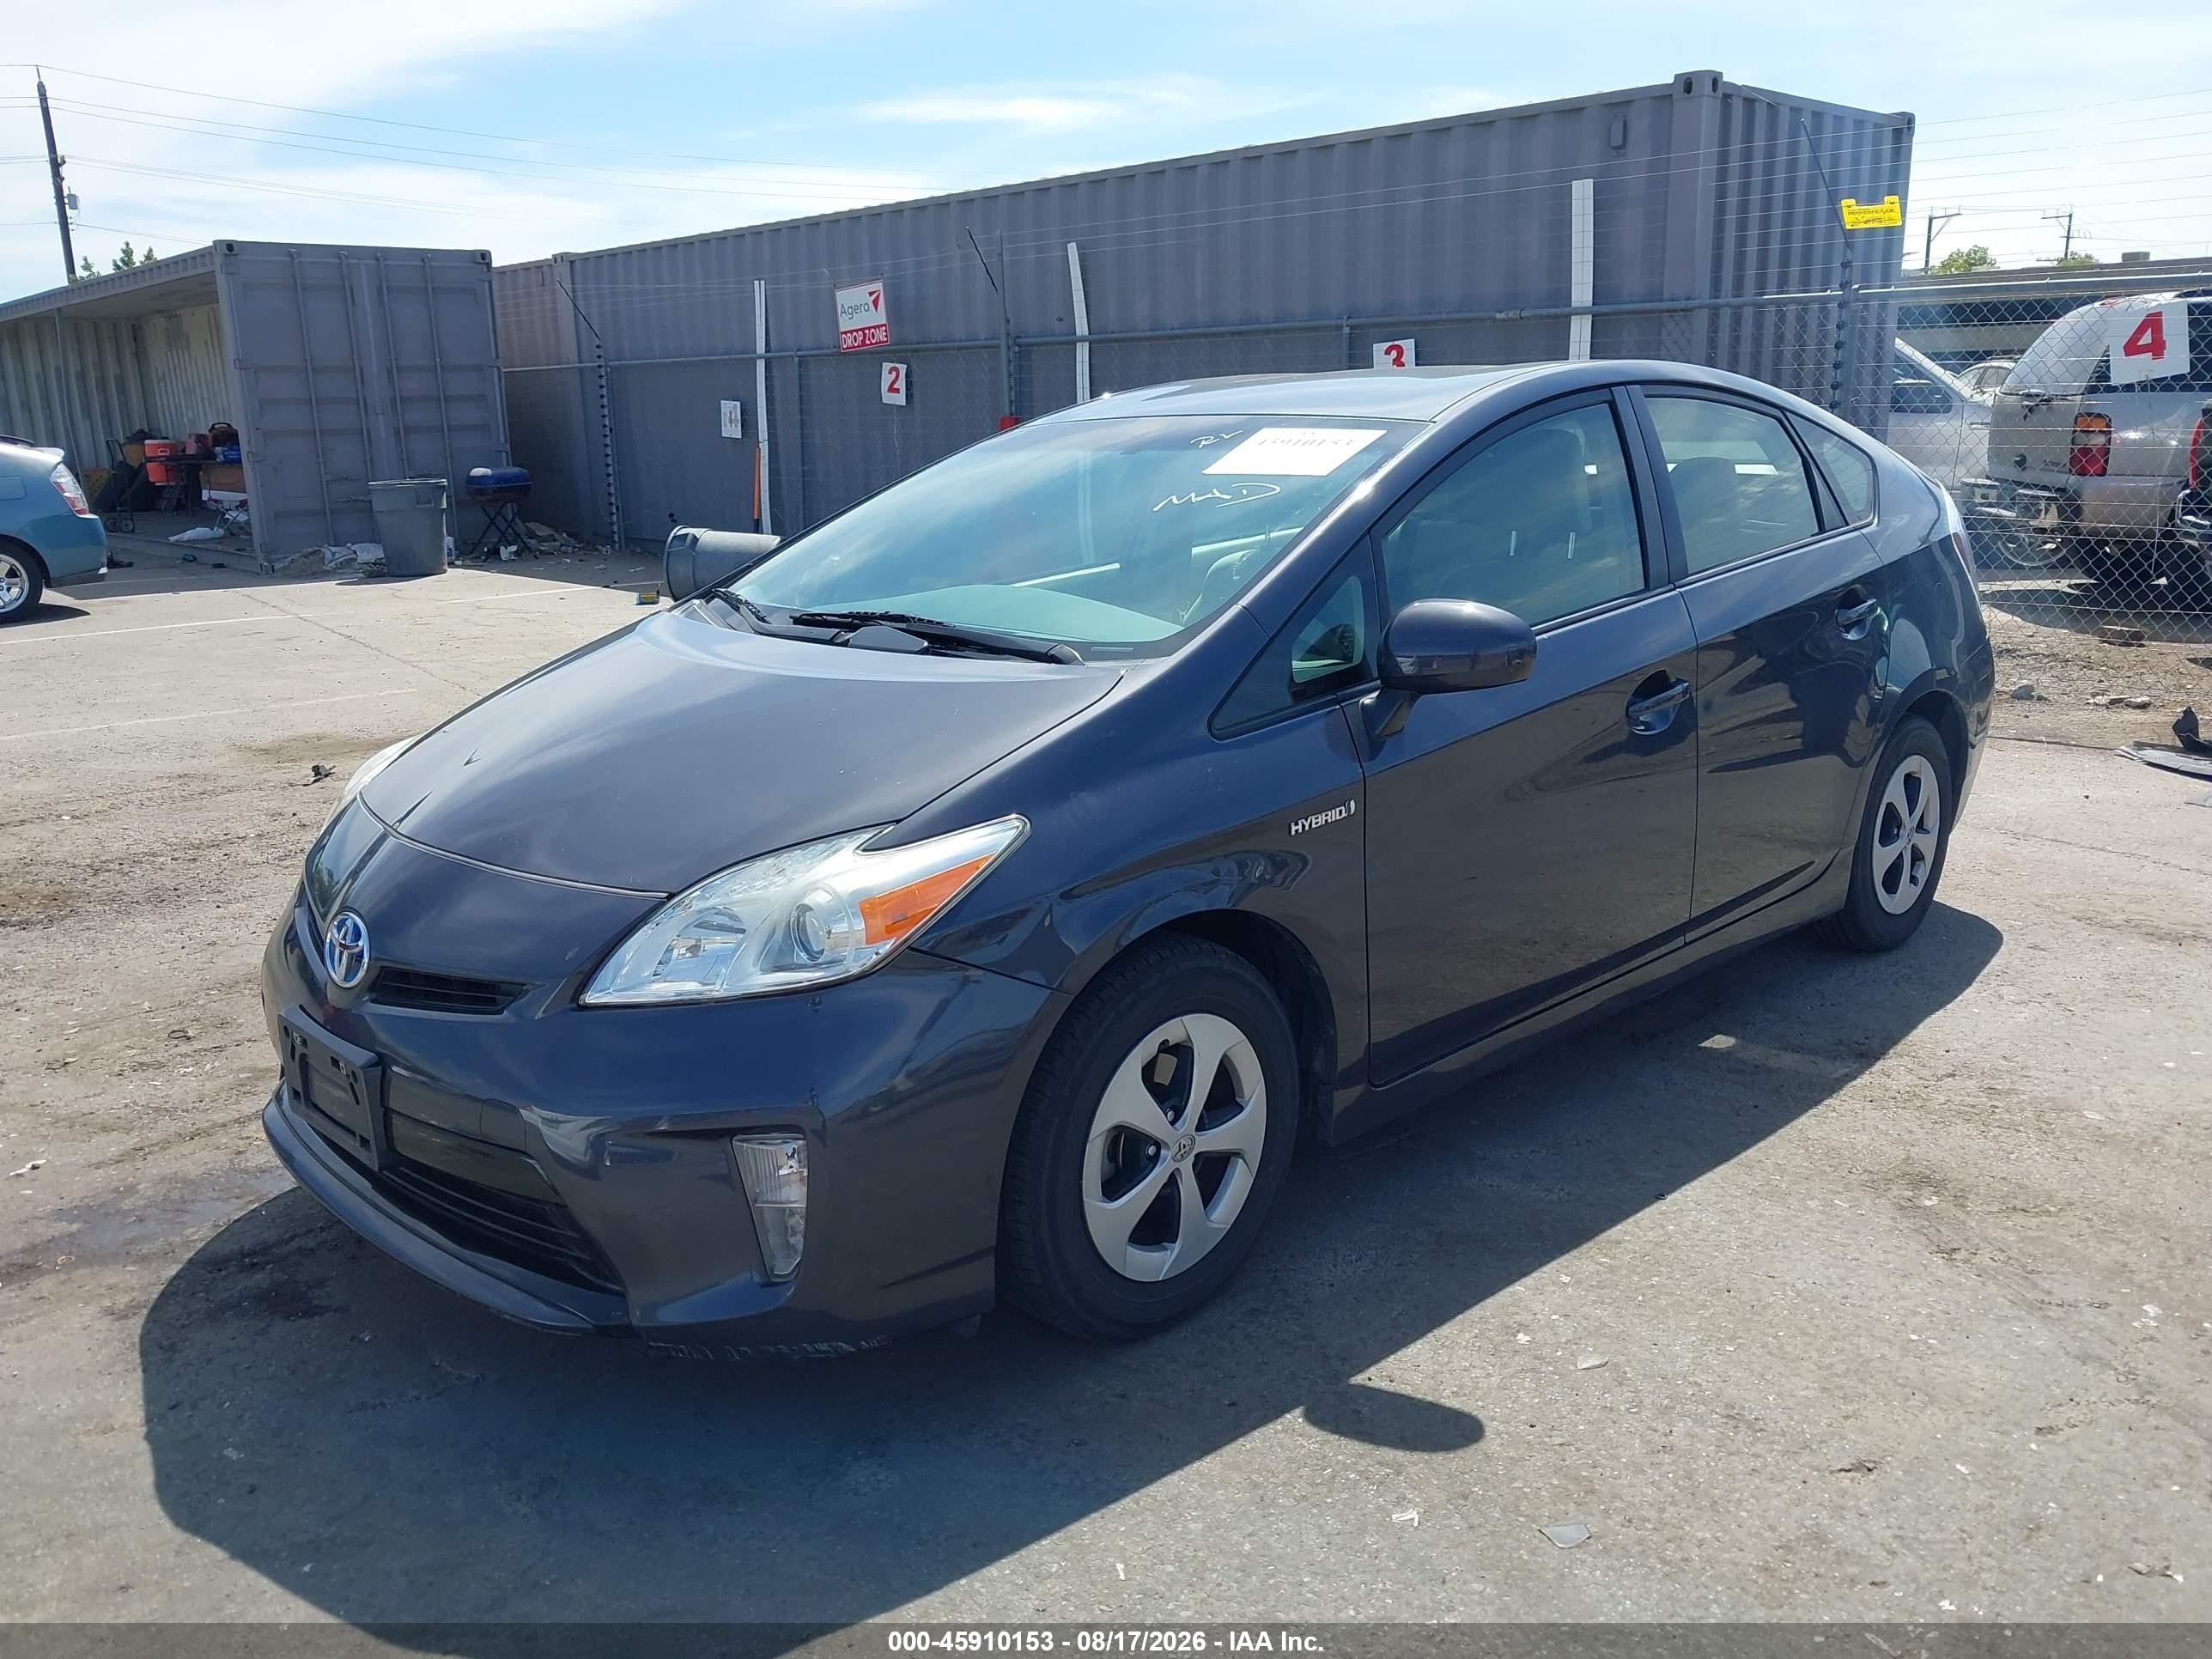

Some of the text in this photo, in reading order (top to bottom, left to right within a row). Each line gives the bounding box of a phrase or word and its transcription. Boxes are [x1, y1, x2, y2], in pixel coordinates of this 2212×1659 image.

[839, 301, 871, 320] Agero
[842, 326, 888, 349] DROP ZONE
[2122, 310, 2167, 361] 4
[886, 366, 901, 394] 2
[1291, 801, 1348, 836] HYBRID
